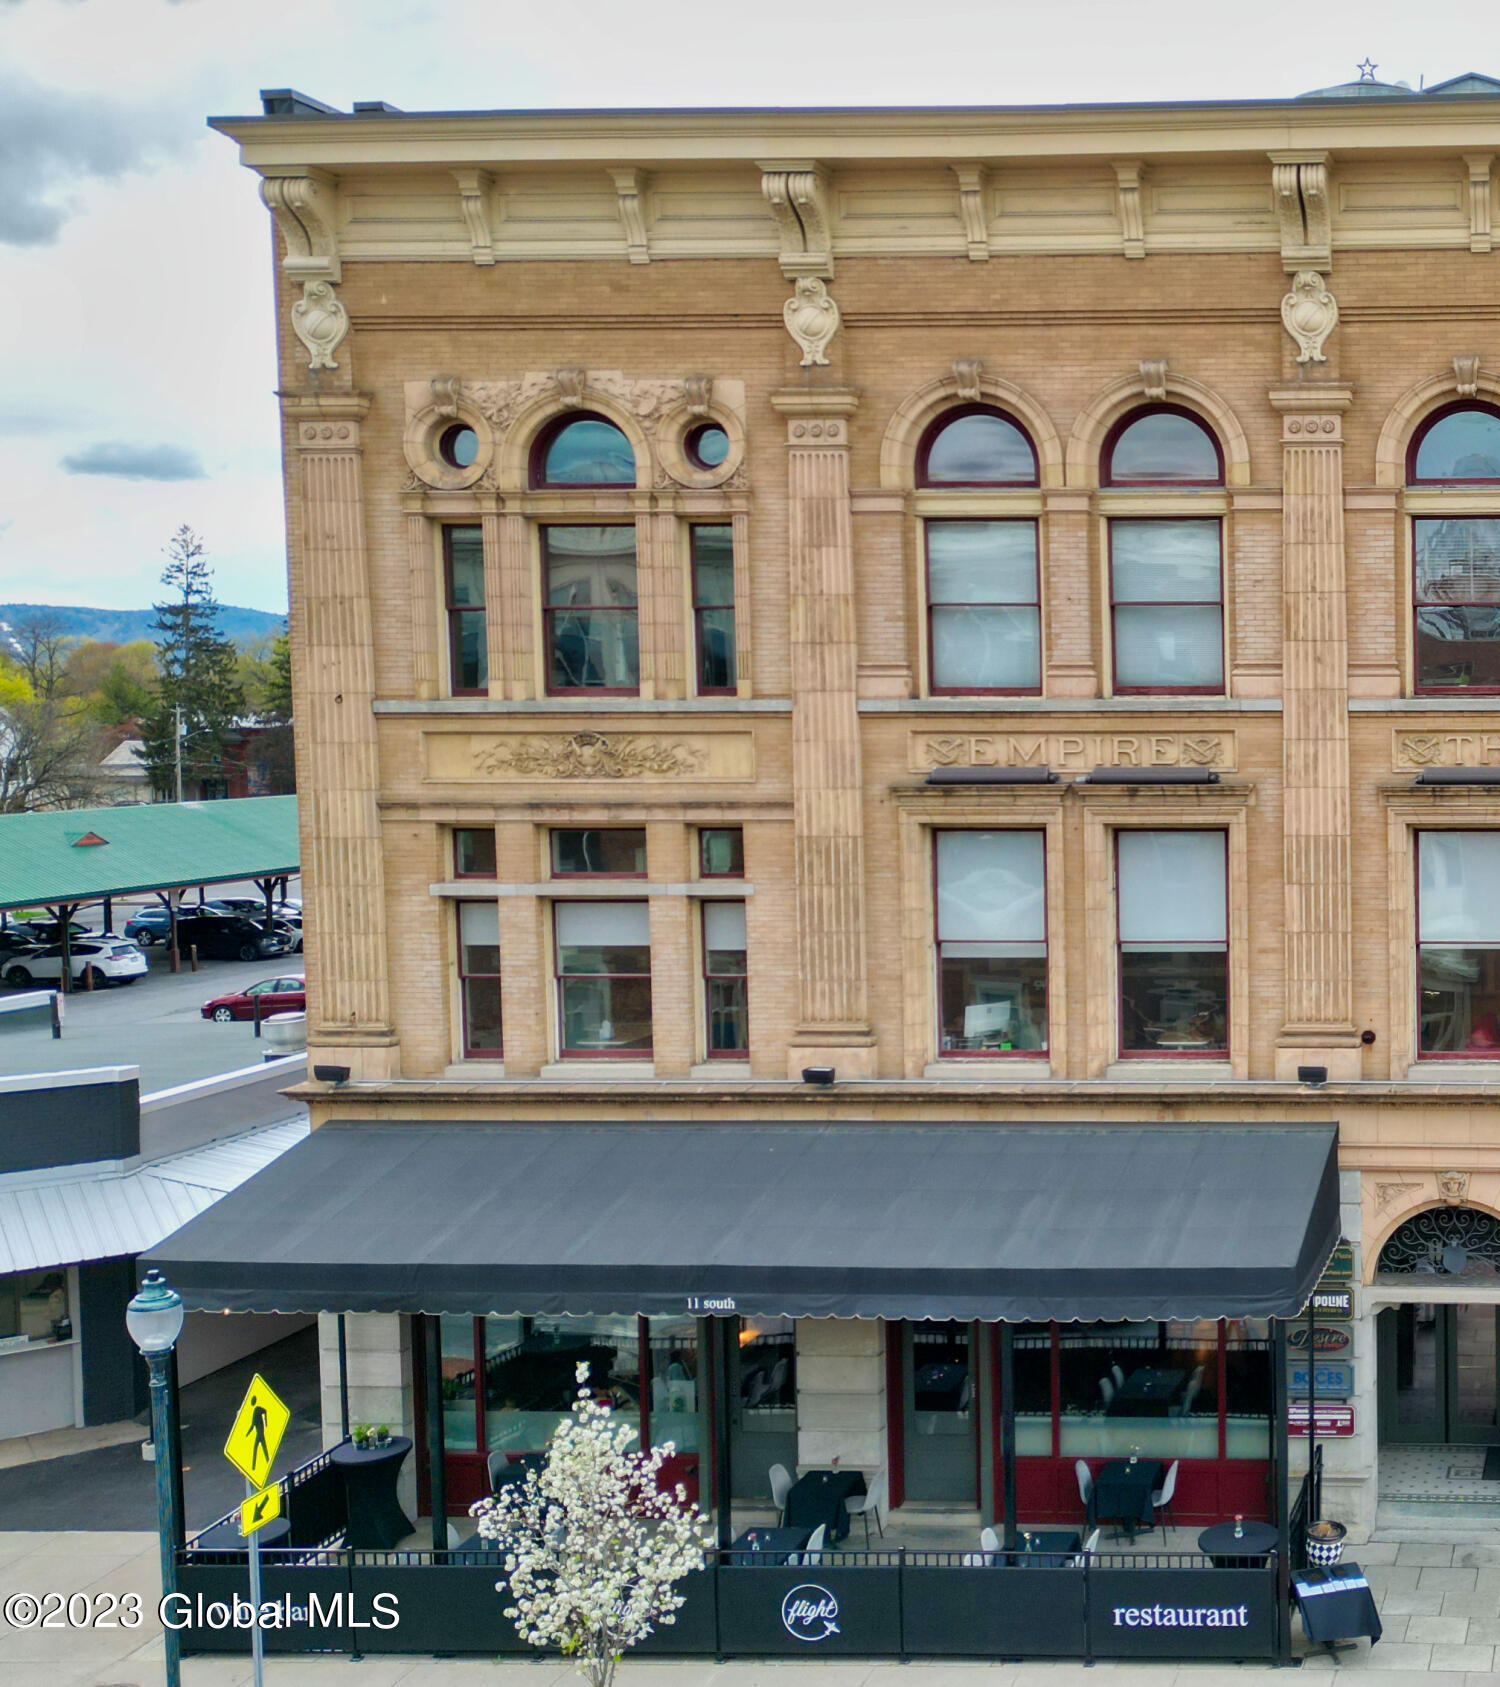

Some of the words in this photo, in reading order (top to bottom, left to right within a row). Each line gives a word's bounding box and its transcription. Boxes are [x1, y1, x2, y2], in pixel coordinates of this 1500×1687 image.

[968, 736, 1178, 766] EMPIRE
[687, 1297, 699, 1309] 11
[703, 1297, 735, 1309] south
[787, 1599, 838, 1625] flight
[1113, 1604, 1248, 1627] restaurant
